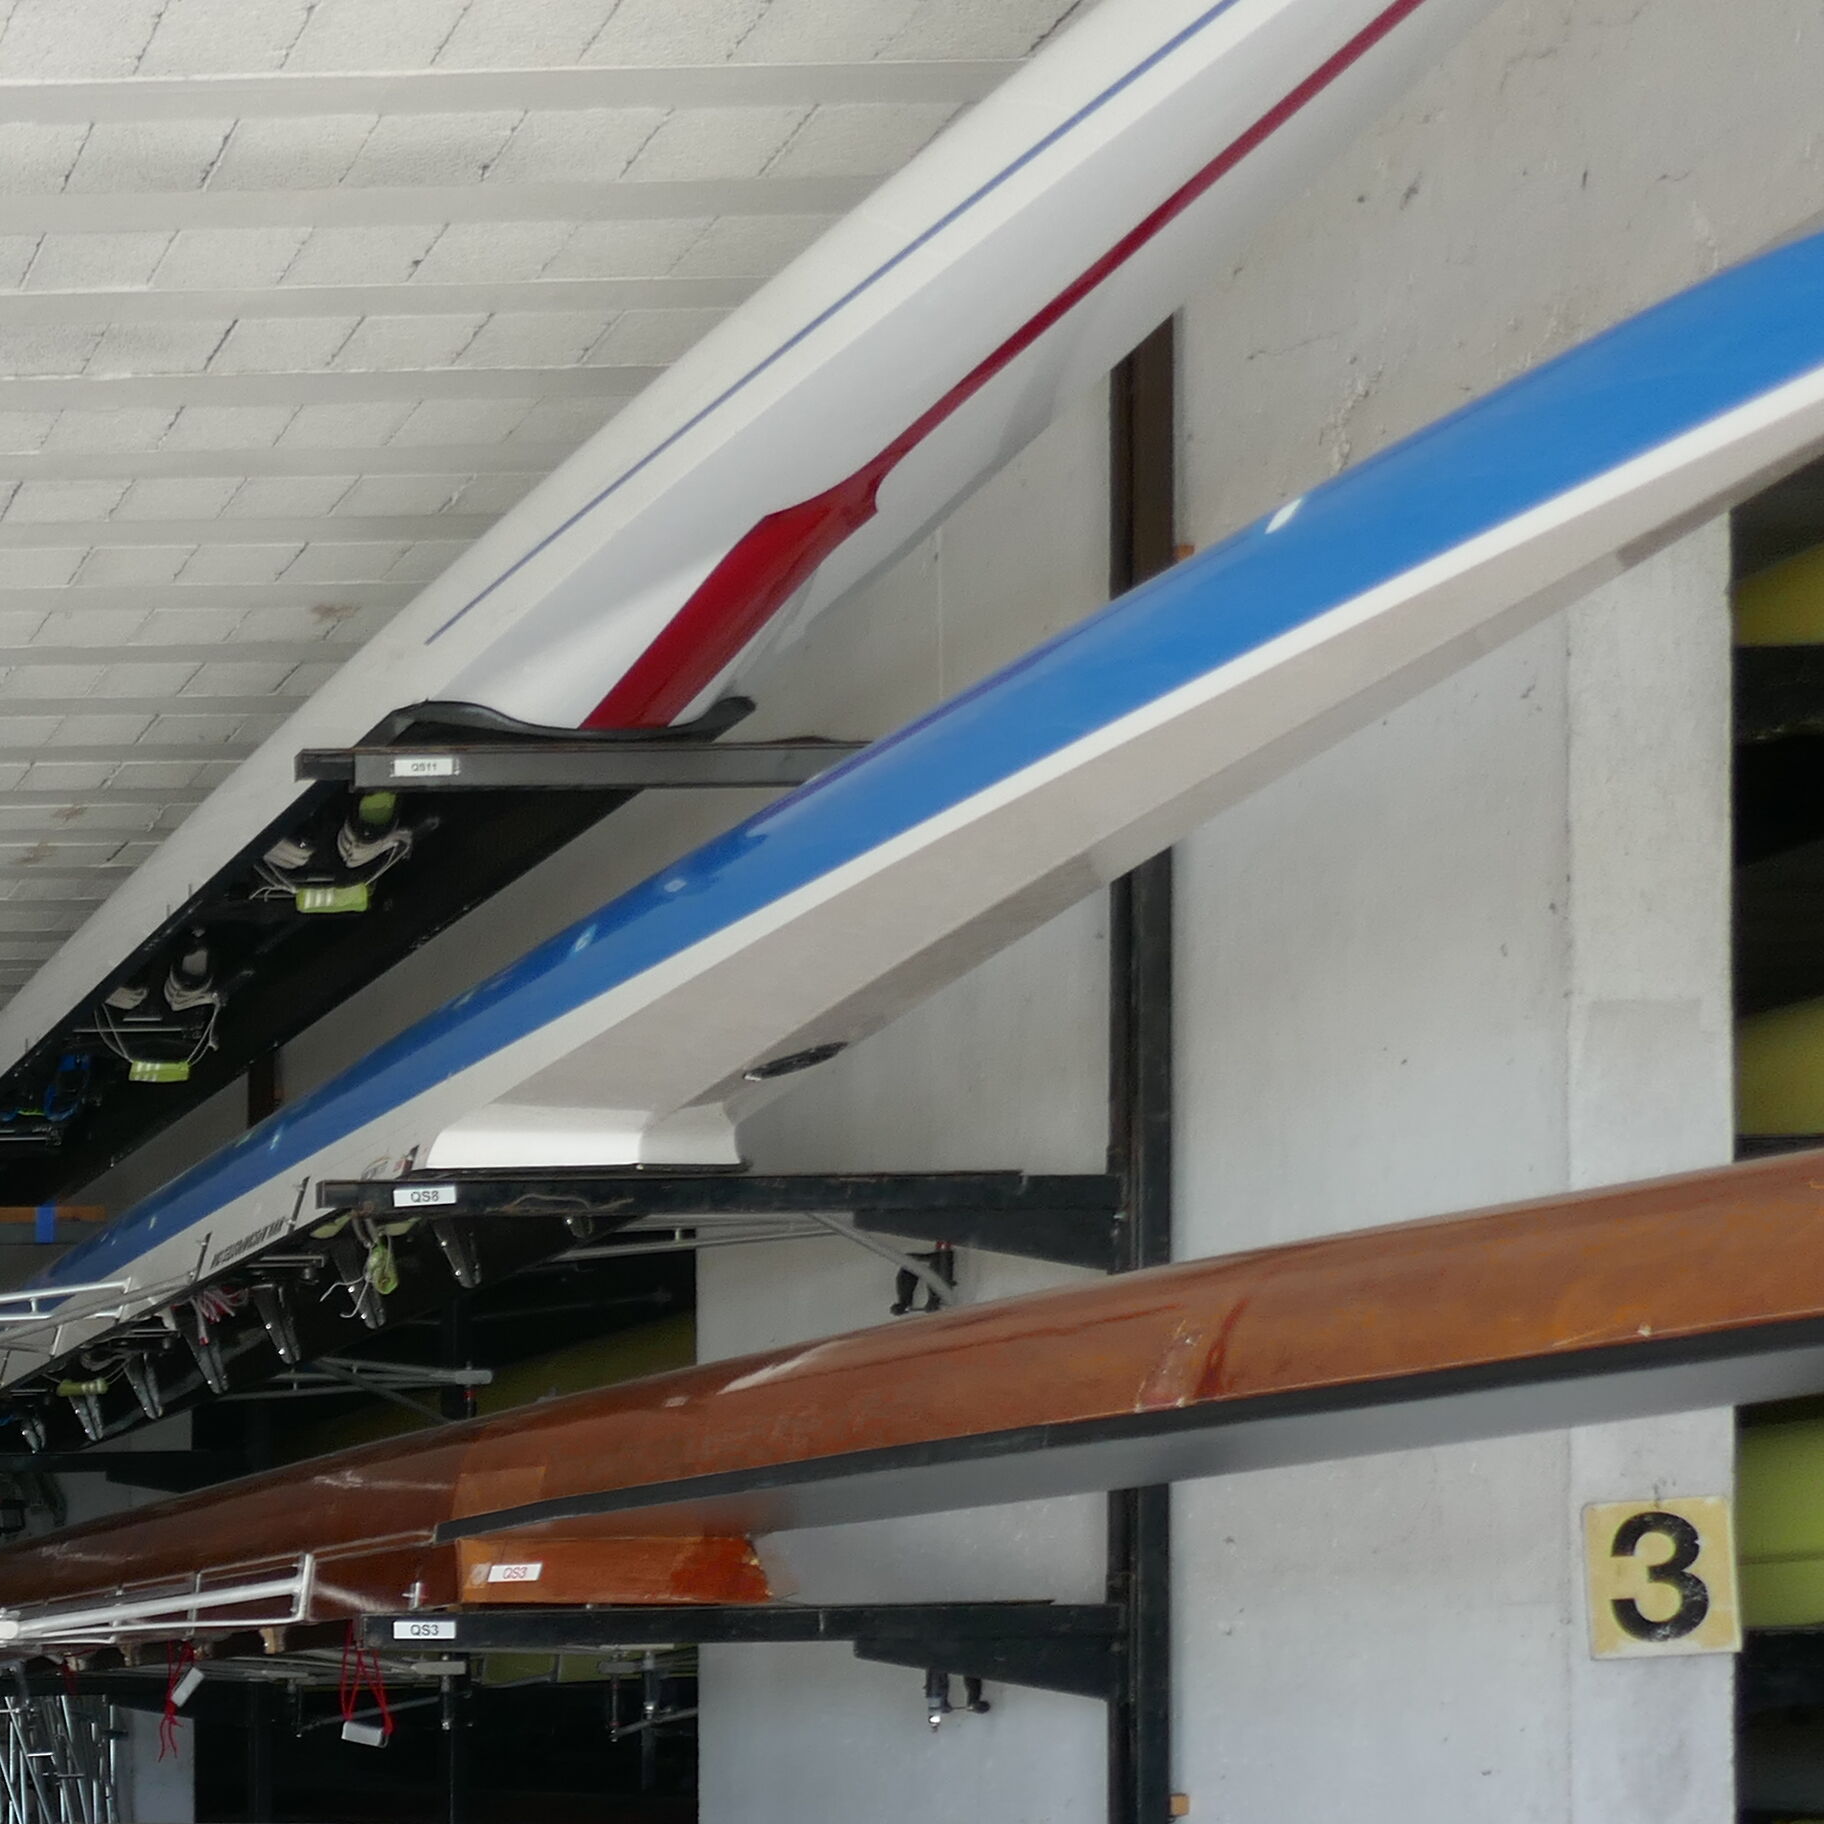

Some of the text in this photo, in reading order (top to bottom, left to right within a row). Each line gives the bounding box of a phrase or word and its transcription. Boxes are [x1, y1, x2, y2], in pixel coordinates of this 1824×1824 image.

[411, 762, 437, 772] QS11
[410, 1190, 440, 1203] QS8
[503, 1567, 528, 1579] QS3
[1611, 1511, 1709, 1642] 3
[410, 1624, 439, 1637] QS3
